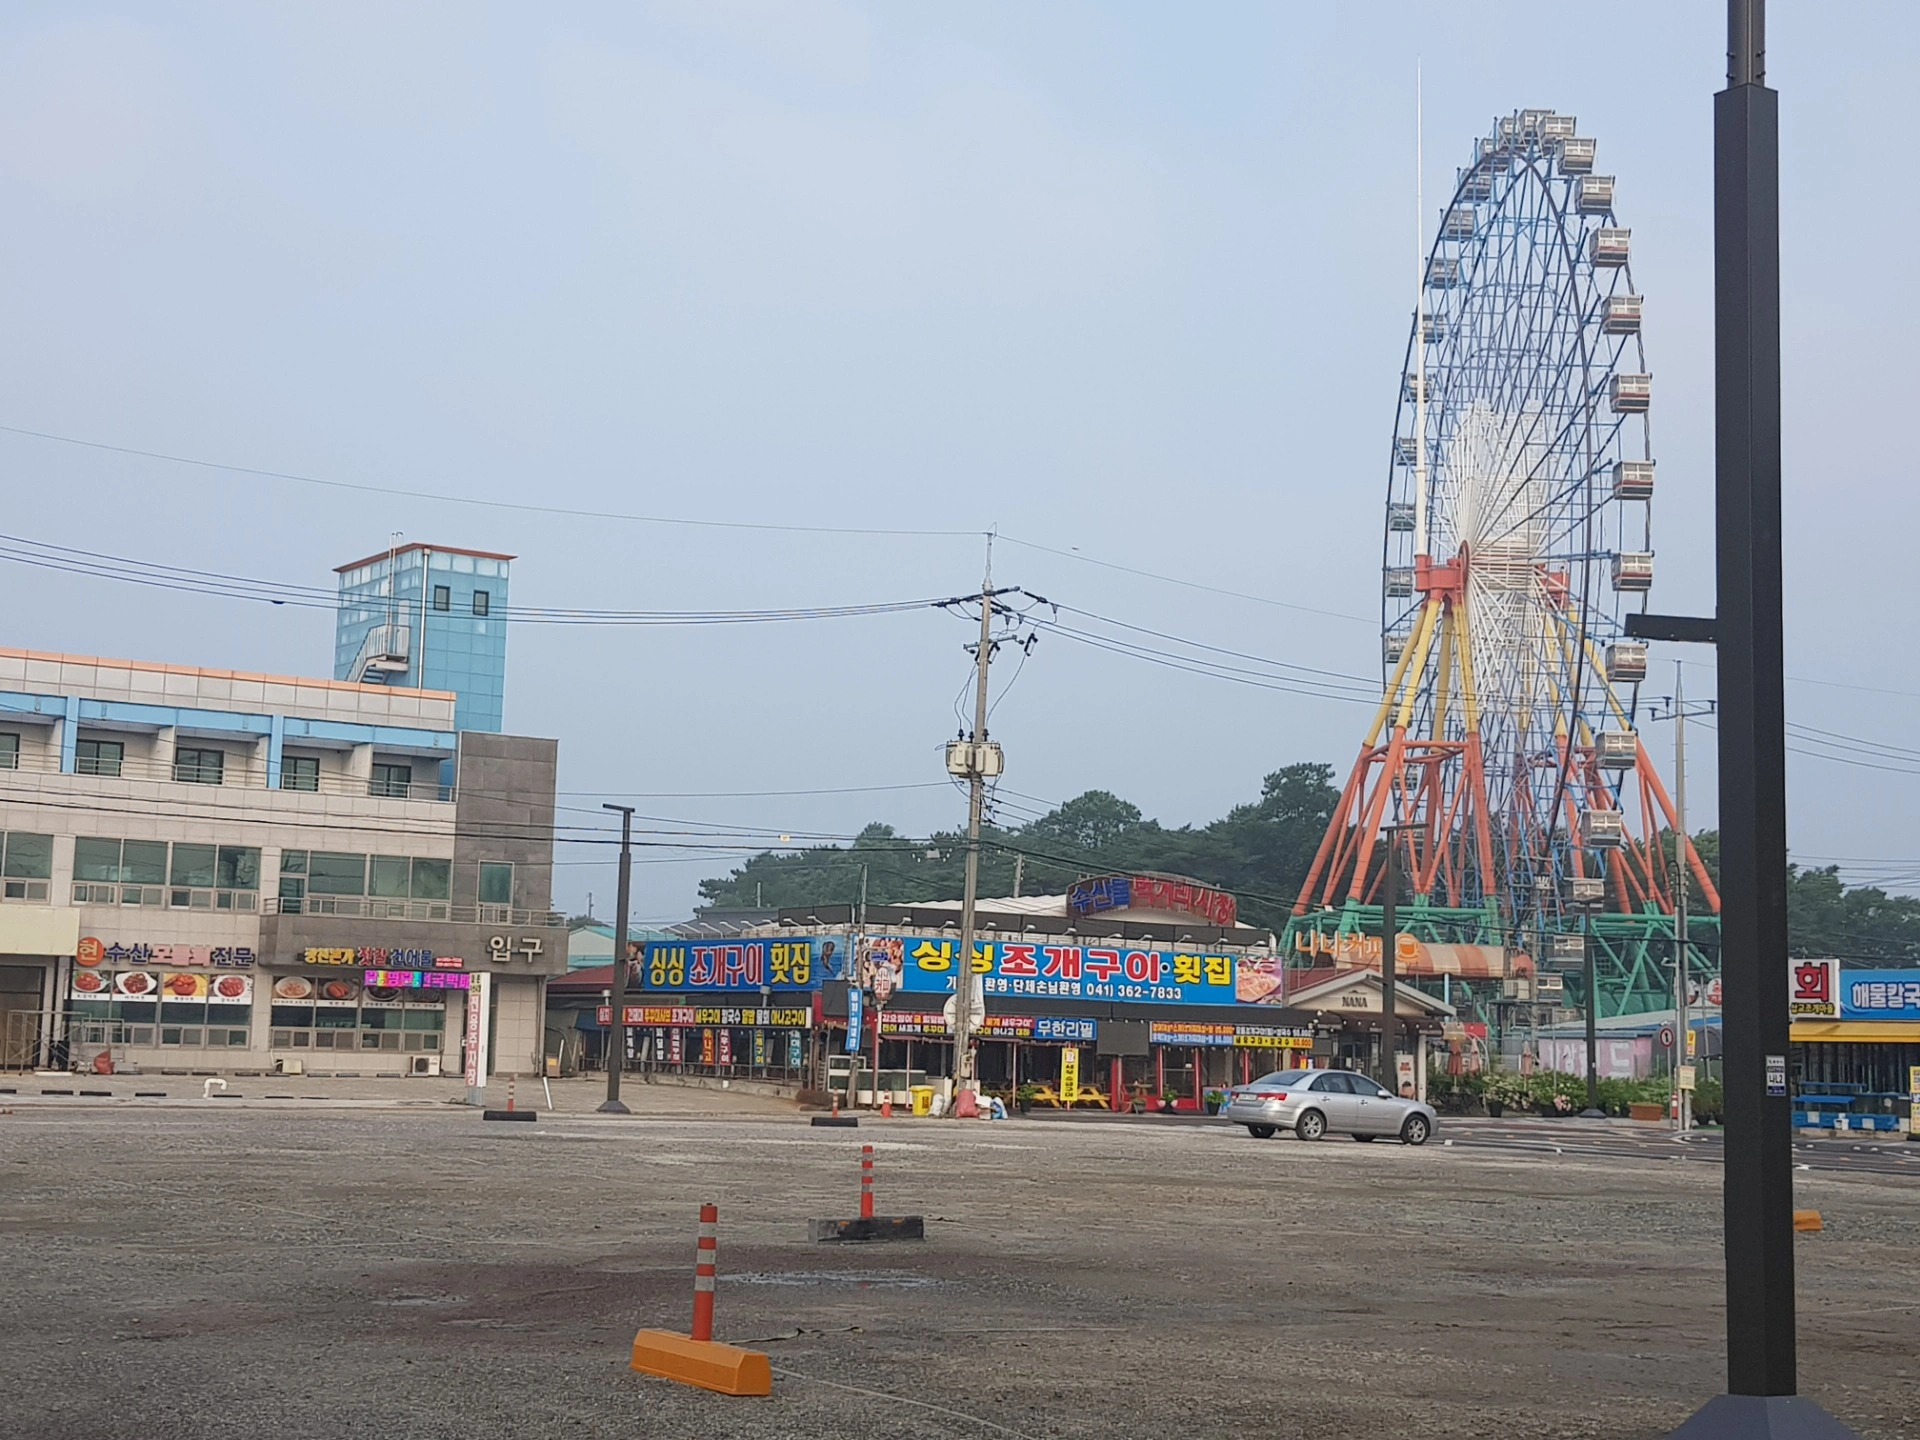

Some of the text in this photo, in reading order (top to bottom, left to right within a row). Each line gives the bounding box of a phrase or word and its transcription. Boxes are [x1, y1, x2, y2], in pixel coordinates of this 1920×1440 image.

[489, 935, 543, 963] 입구
[649, 941, 811, 987] 싱싱 조개구이 횟집
[1086, 982, 1114, 998] 041)
[1117, 983, 1183, 999] 362-7833
[1794, 961, 1830, 1002] 회
[1341, 996, 1368, 1008] NANA
[771, 1009, 806, 1025] 아나고구이
[1037, 1019, 1094, 1039] 무한리필
